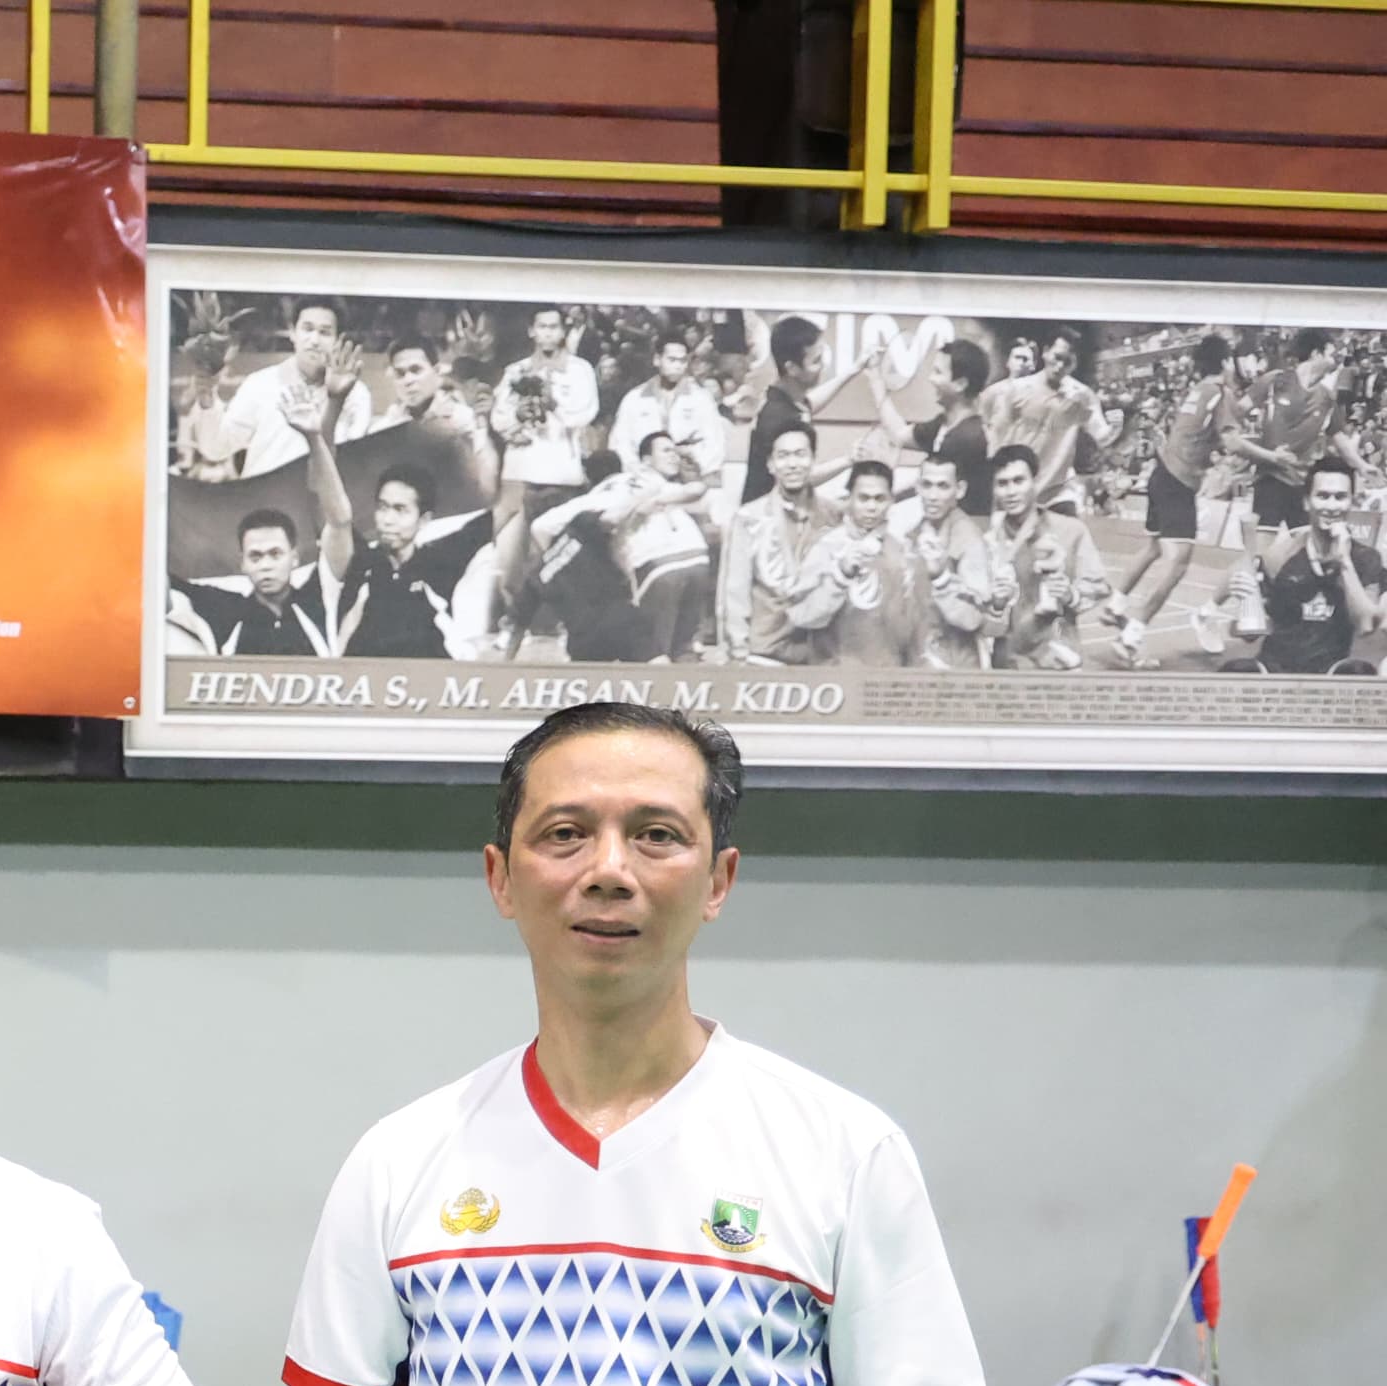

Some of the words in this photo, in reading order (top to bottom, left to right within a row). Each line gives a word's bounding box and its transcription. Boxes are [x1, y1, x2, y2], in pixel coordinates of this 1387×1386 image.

[186, 671, 373, 707] HENDRA
[384, 675, 427, 713] S.,
[438, 677, 489, 709] M.
[672, 680, 720, 711] M.
[730, 682, 845, 714] KIDO
